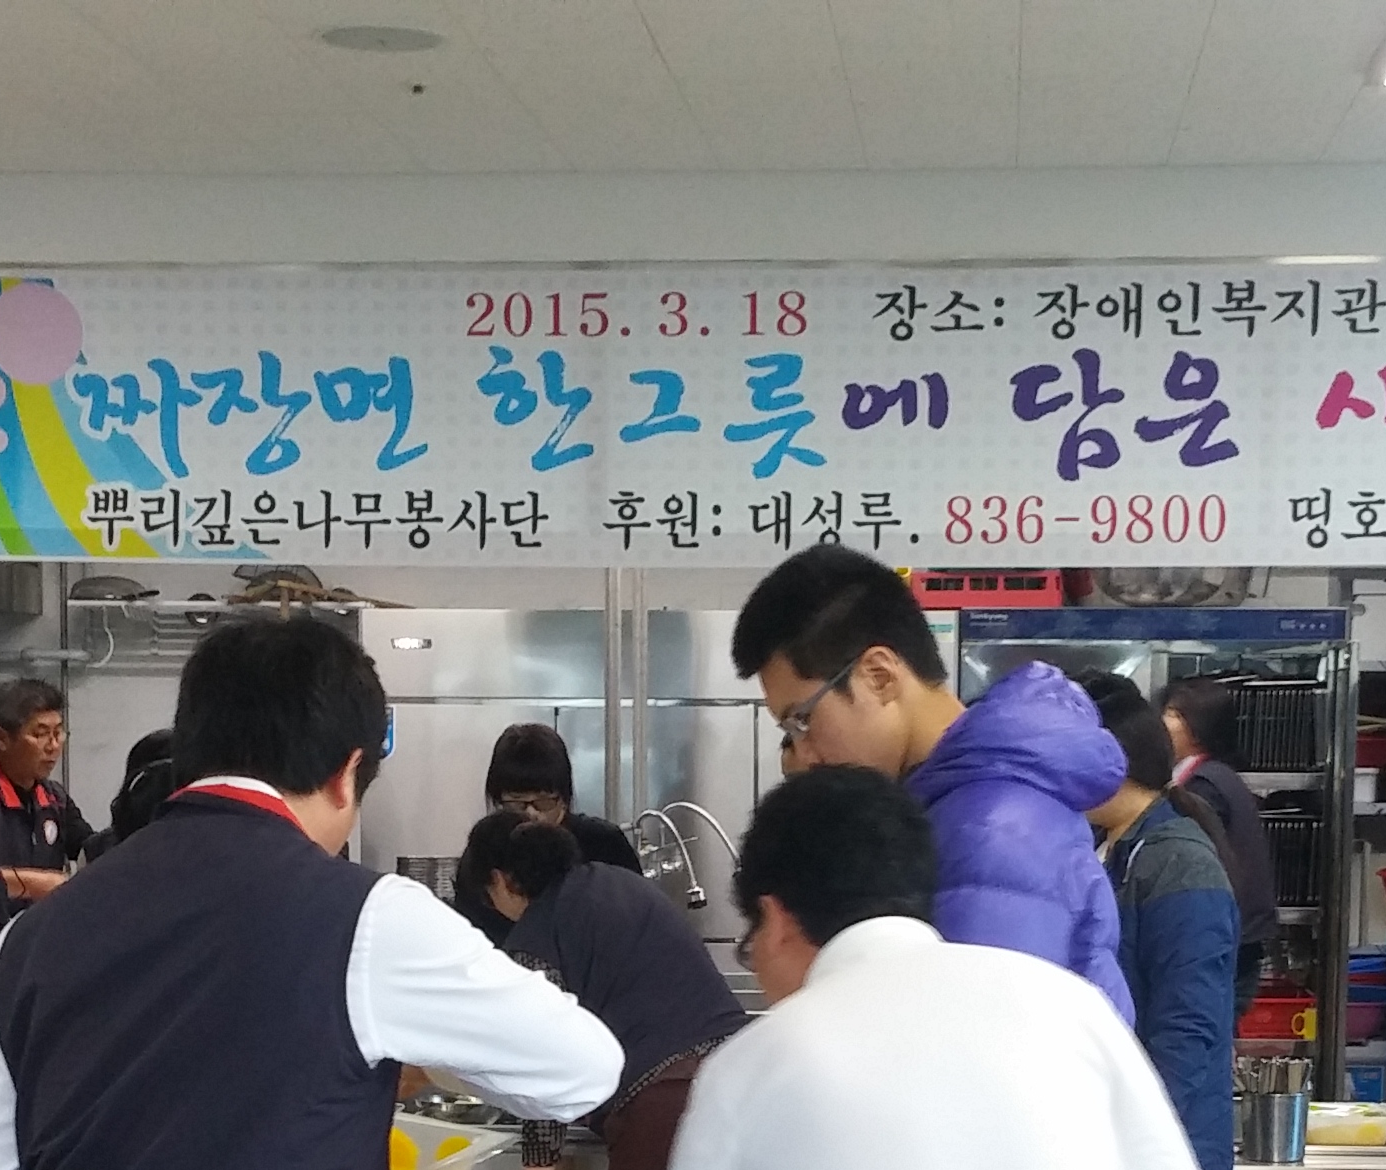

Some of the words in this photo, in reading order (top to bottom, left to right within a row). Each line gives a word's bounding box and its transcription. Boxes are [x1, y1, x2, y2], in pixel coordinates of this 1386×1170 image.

[874, 285, 1007, 342] 장소:
[73, 350, 430, 478] 짜장면
[1009, 347, 1242, 481] 담은
[86, 488, 550, 550] 뿌리깊은나무봉사단
[602, 490, 724, 551] 후원:
[943, 495, 1228, 545] 836-9800
